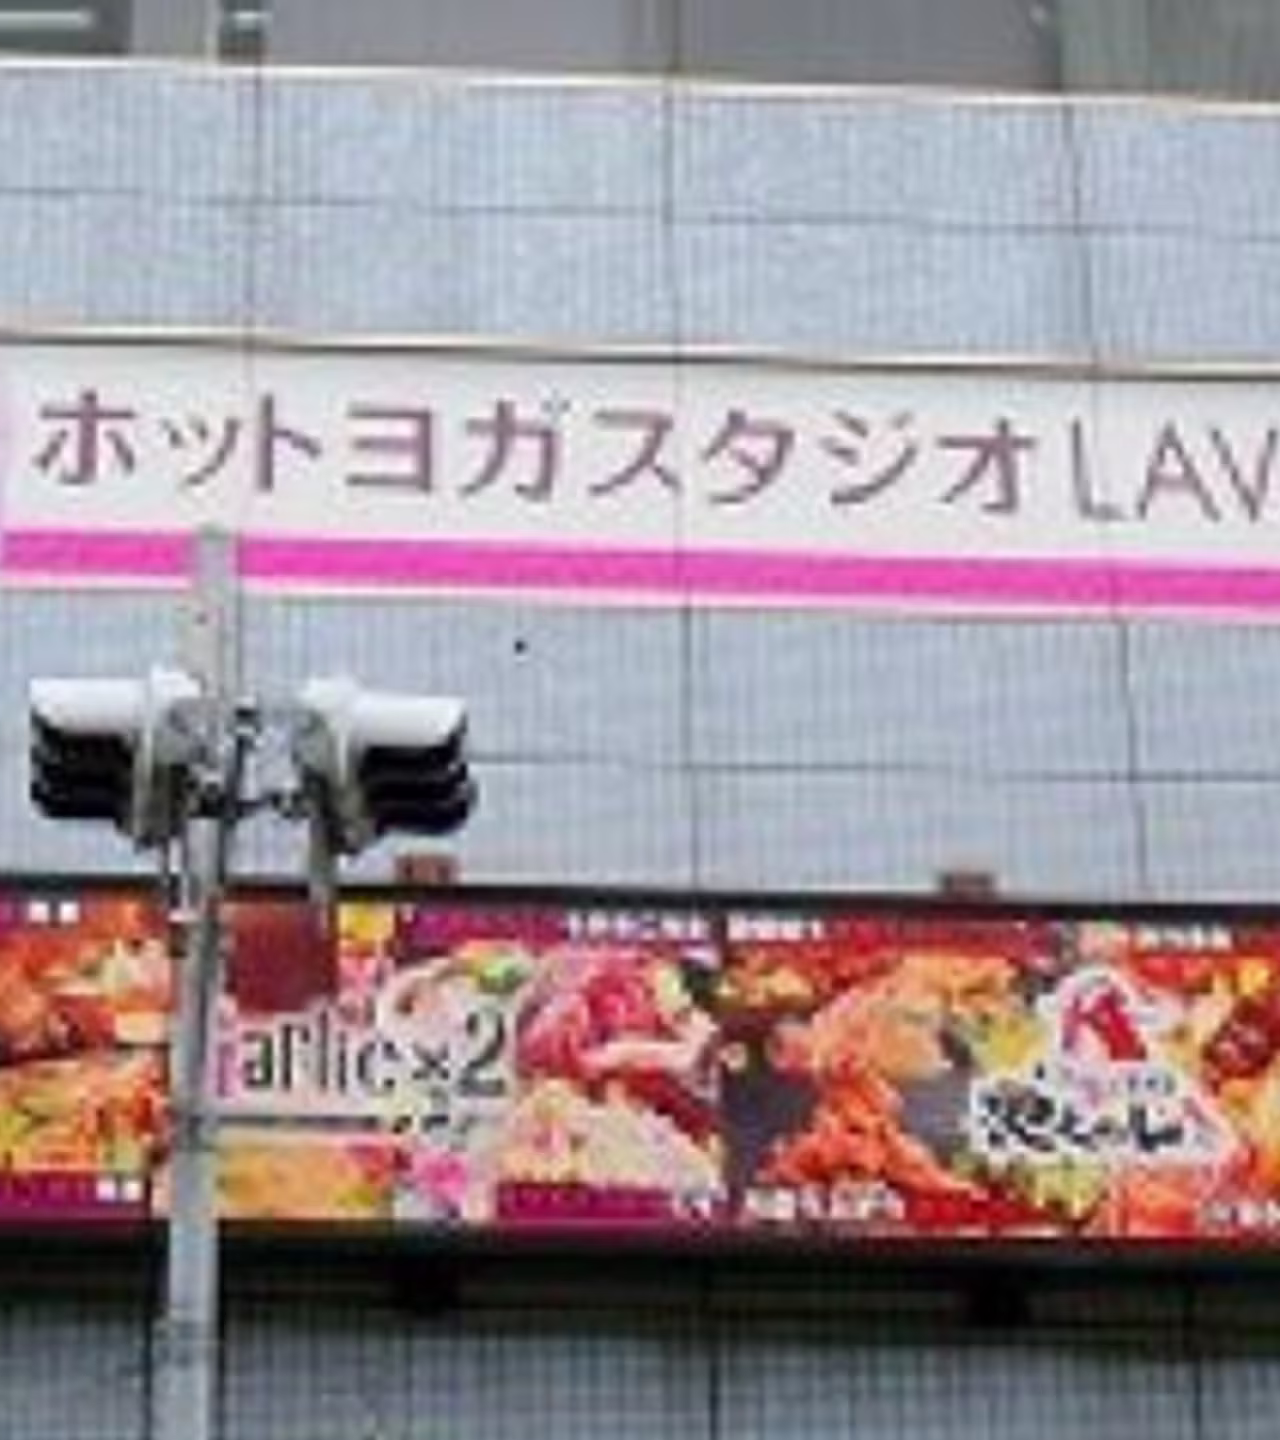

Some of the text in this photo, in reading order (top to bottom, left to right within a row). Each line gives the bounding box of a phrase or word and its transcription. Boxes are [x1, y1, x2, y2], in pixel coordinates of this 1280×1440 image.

[30, 388, 1036, 518] ホットヨガスタジオ
